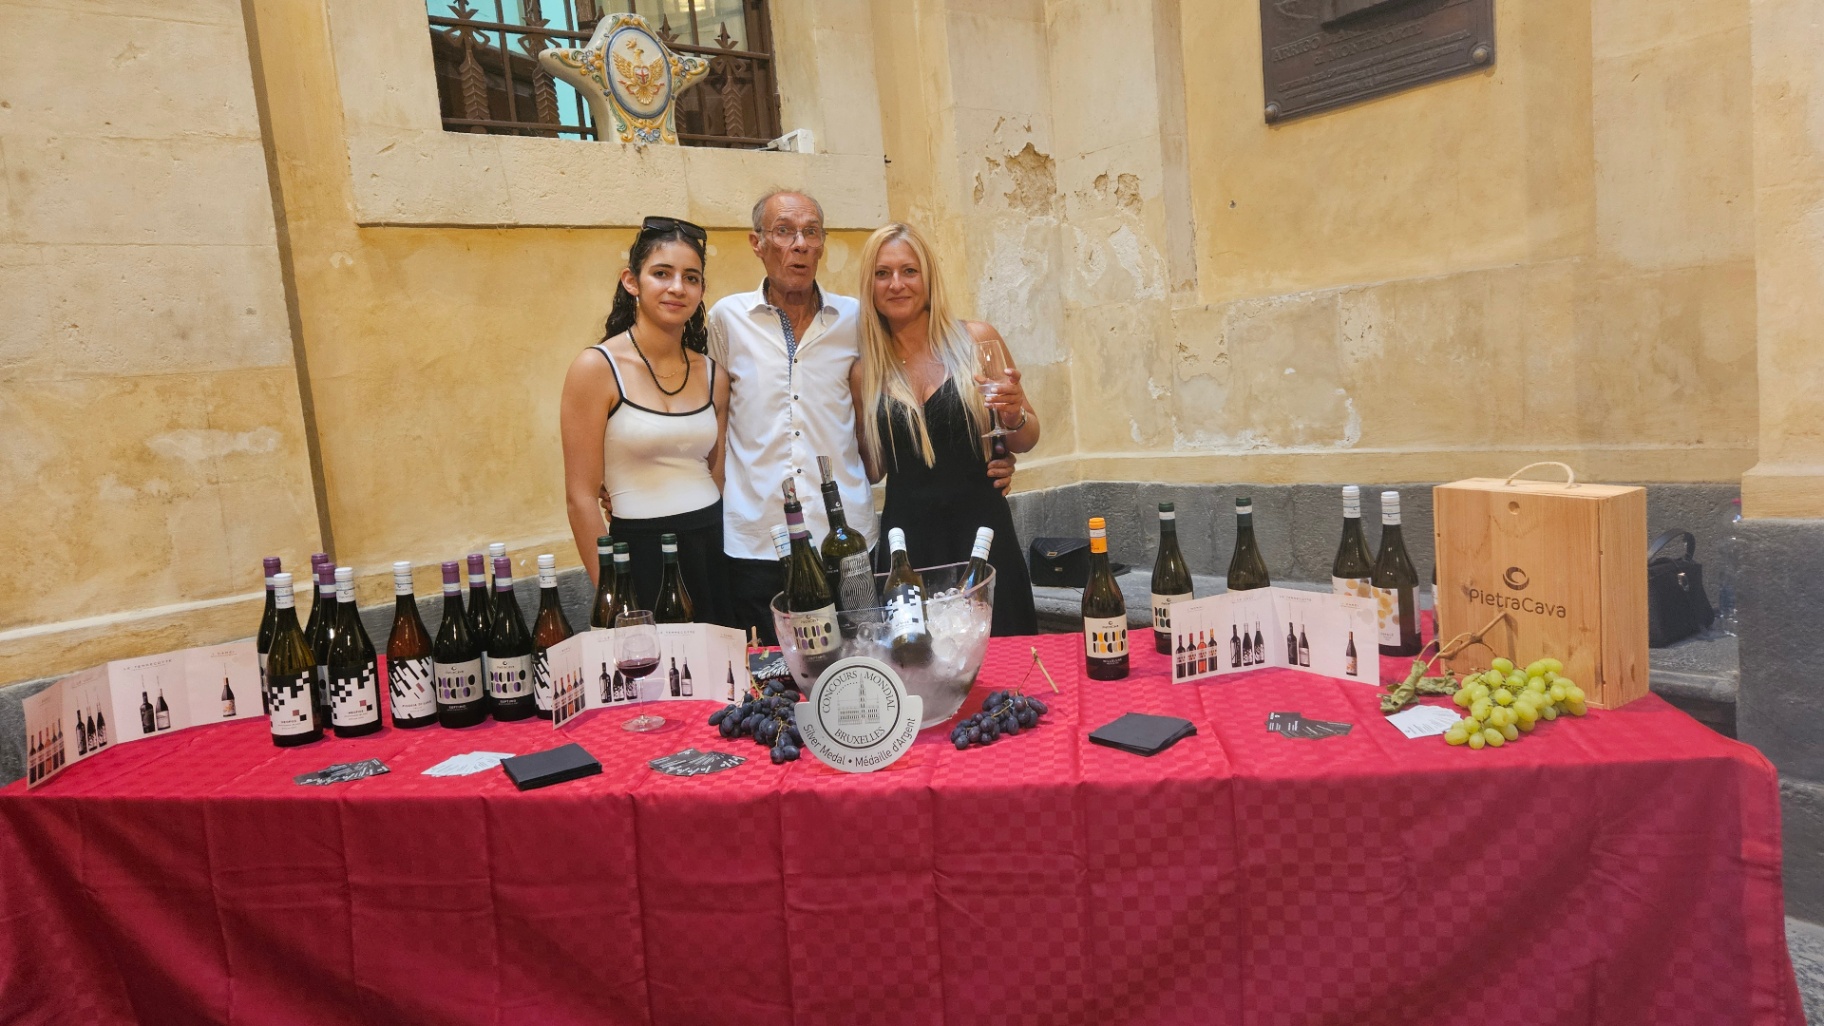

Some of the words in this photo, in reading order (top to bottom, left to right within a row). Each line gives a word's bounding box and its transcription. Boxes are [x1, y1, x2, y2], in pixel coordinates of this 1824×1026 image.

[1469, 588, 1567, 618] PietraCava
[823, 671, 858, 714] CONCOURS
[864, 671, 895, 711] MONDIAL
[803, 724, 821, 748] Silver
[820, 745, 845, 765] Medal
[855, 750, 892, 767] Médaille
[892, 718, 915, 752] d'Argent
[834, 727, 885, 745] BRUXELLES
